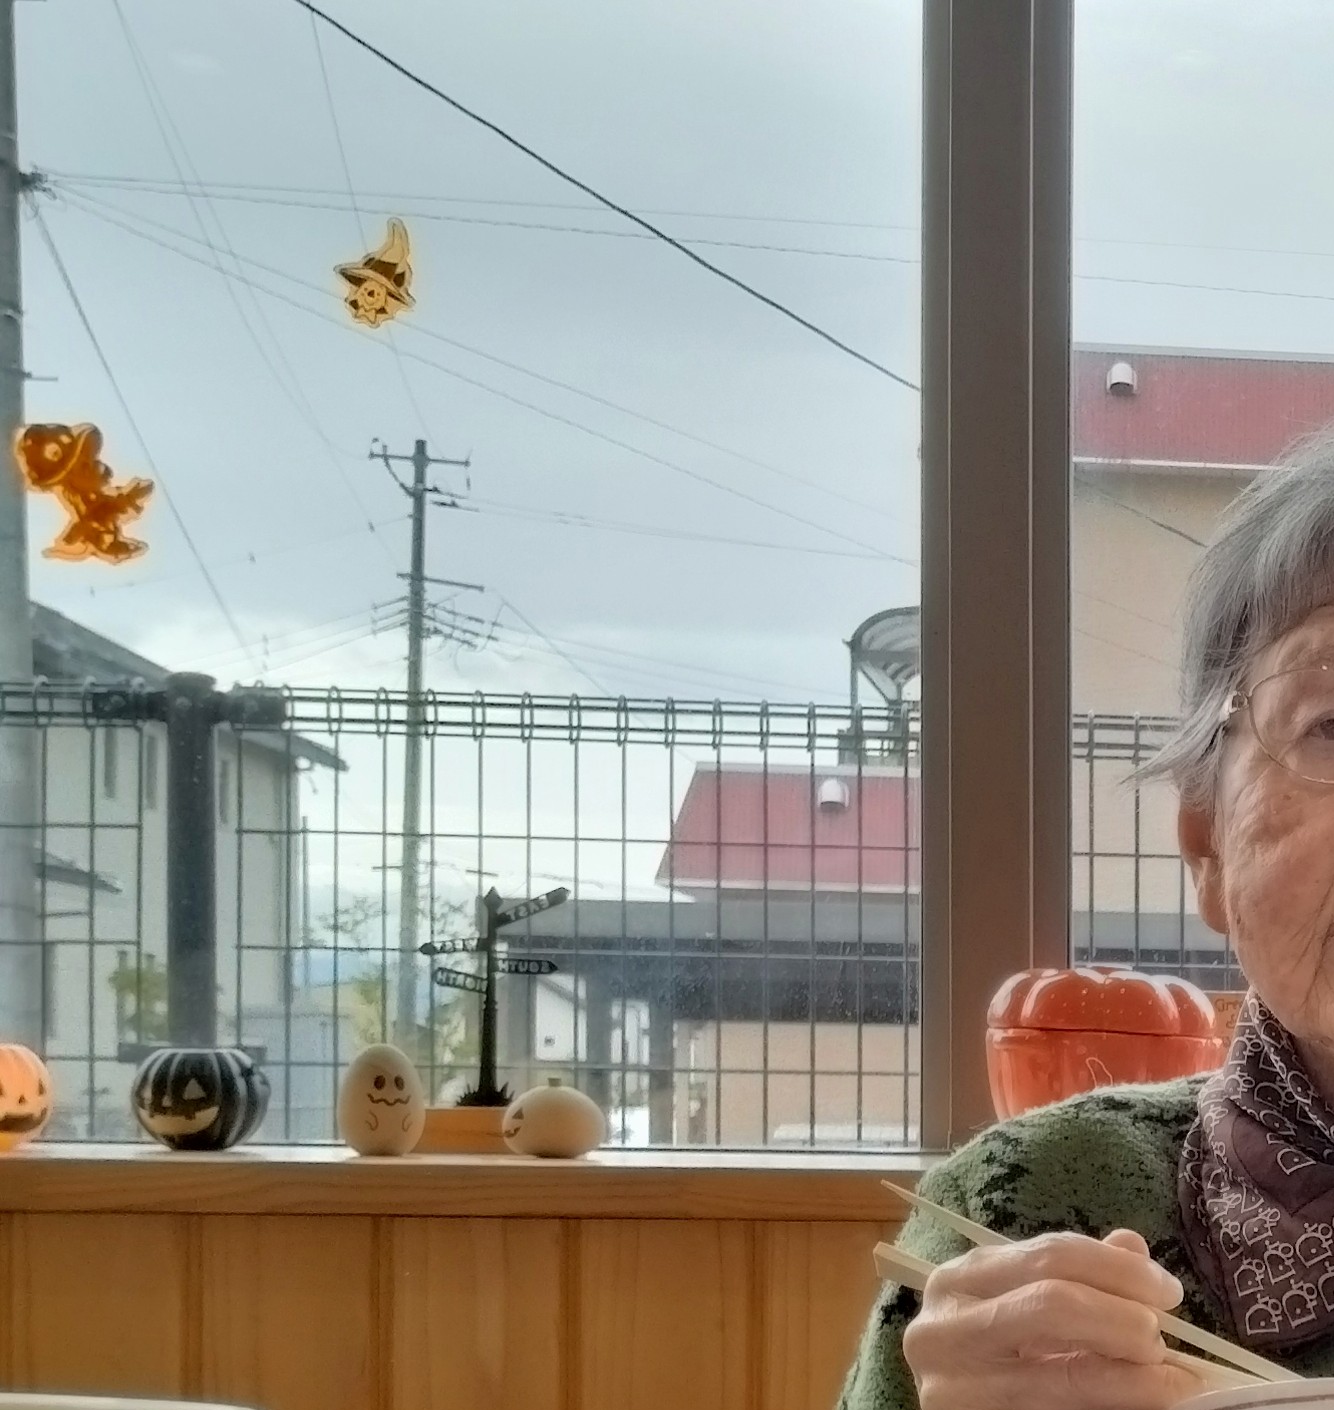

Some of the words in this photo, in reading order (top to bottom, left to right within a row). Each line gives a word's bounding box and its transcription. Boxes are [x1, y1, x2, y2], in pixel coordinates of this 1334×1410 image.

[1263, 1240, 1296, 1285] Dior
[1295, 1222, 1334, 1268] Dior
[1245, 1293, 1282, 1336] Dior
[1281, 1279, 1318, 1329] Dior
